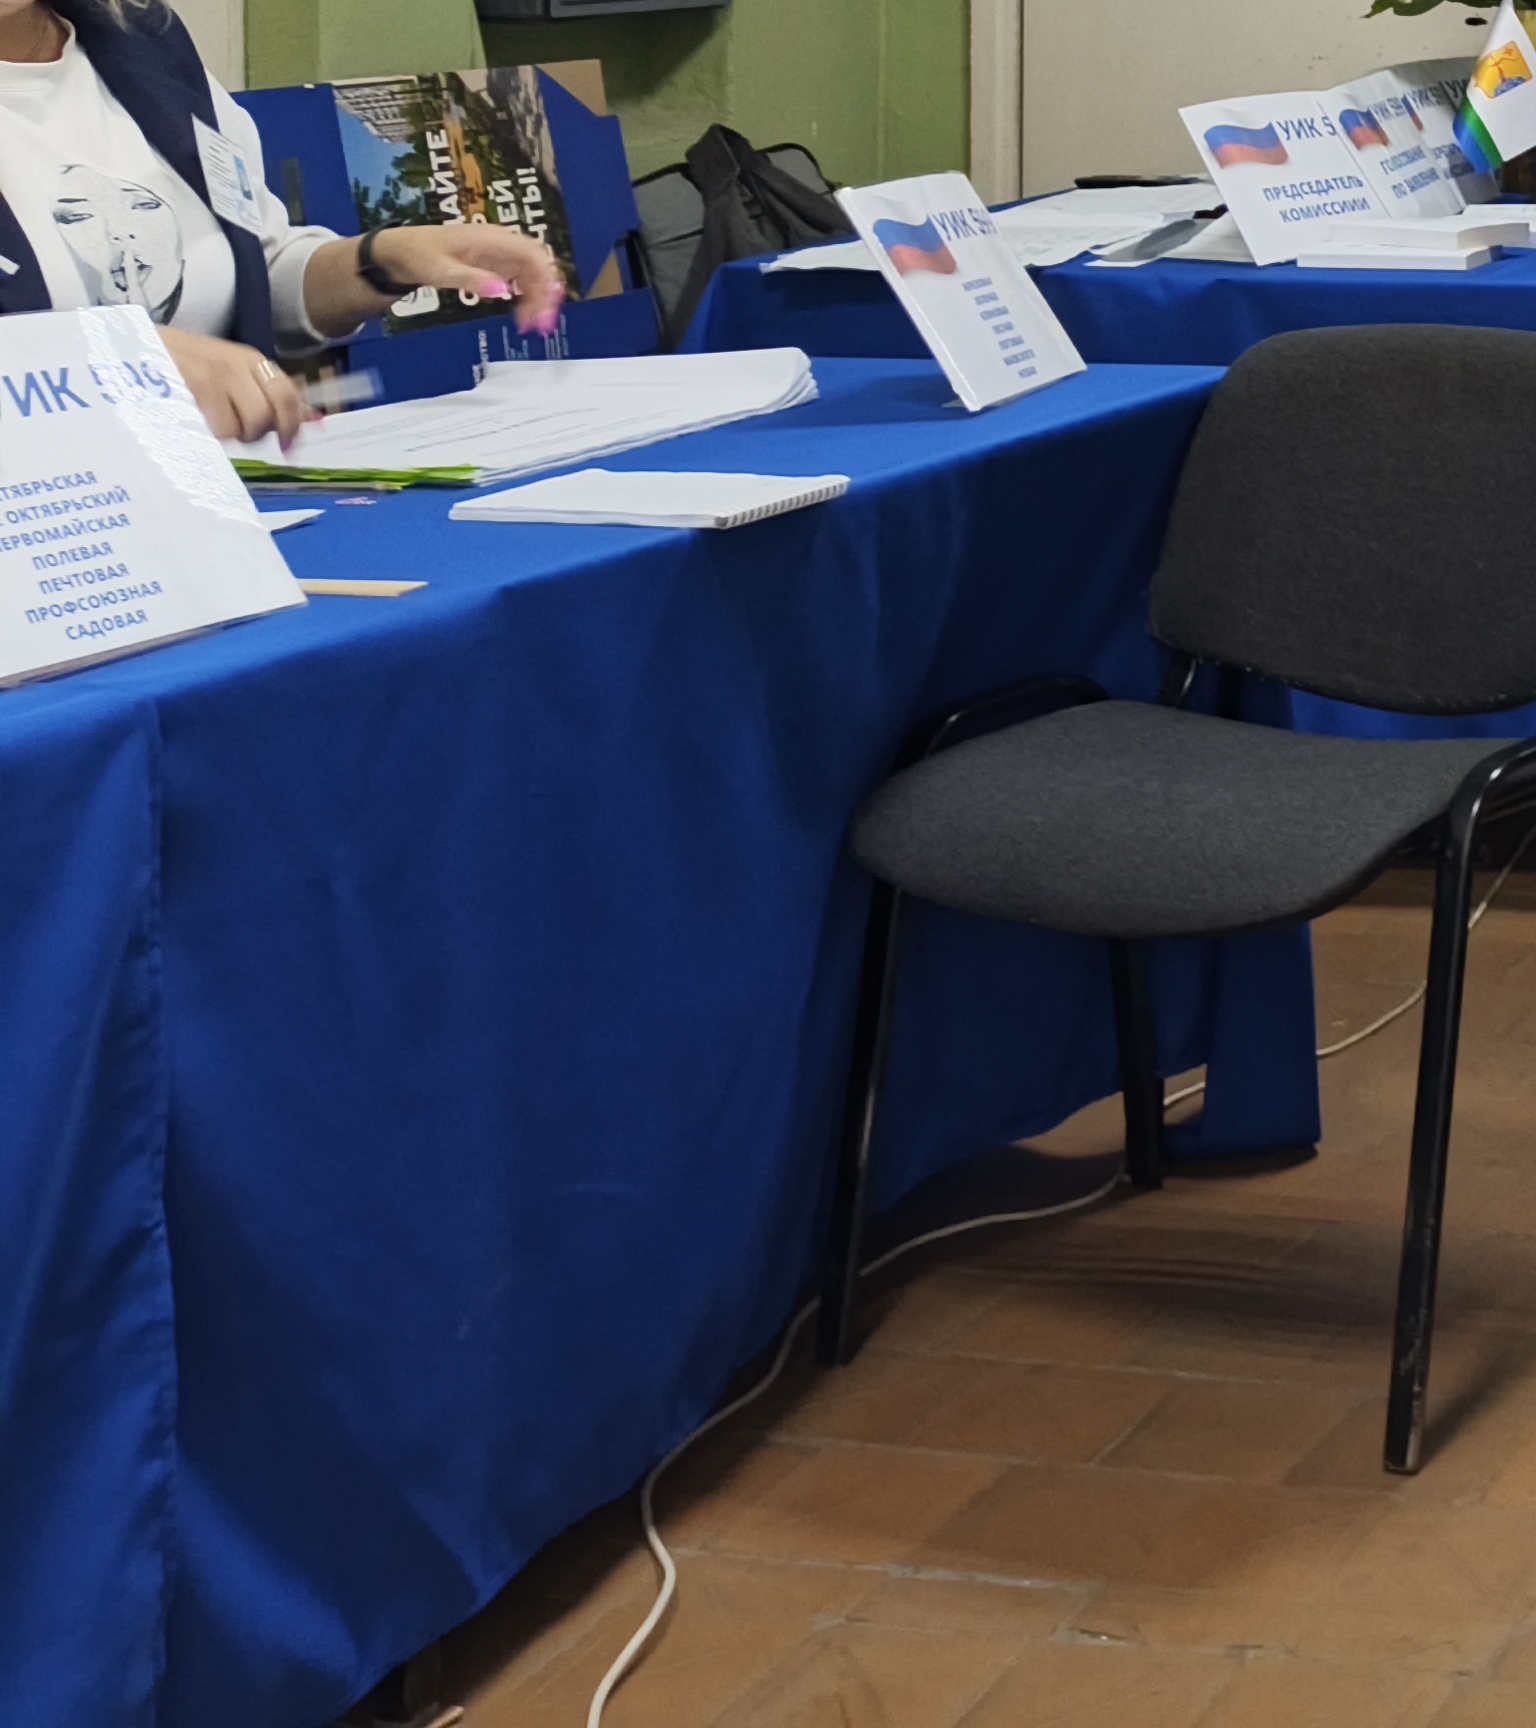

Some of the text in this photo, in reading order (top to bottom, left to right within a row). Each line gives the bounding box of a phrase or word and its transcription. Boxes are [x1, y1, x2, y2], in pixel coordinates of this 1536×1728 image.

[1276, 118, 1323, 140] УИК
[1263, 176, 1364, 201] ПРЕДСЕДАТЕЛЬ
[933, 209, 977, 241] УИК
[0, 366, 90, 418] ИК
[0, 471, 98, 502] ТЯБРЬСКАЯ
[6, 485, 131, 524] ОКТЯБРЬСКИЙ
[32, 542, 114, 570] ПОЛЕВАЯ
[39, 562, 130, 595] ПЕЧТОВАЯ
[25, 580, 163, 624] ПРОФСОЮЗНАЯ
[66, 609, 148, 641] САДОВАЯ
